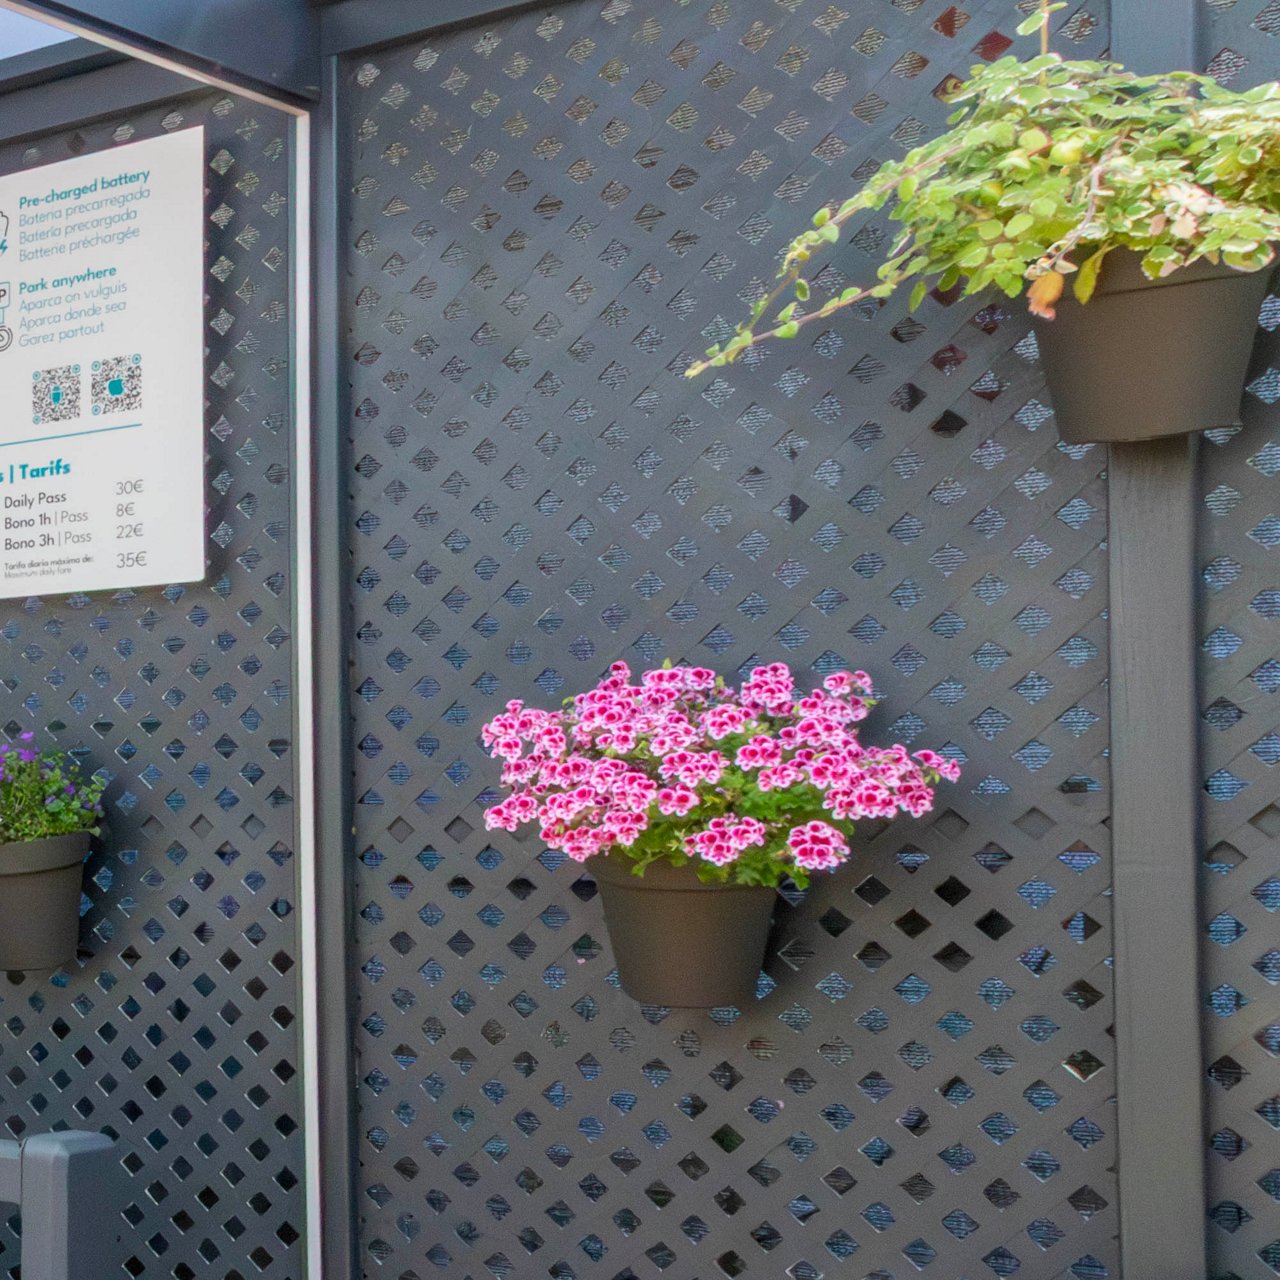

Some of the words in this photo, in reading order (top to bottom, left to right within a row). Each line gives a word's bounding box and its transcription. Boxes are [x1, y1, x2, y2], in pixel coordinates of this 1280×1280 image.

[19, 178, 98, 209] Pre-charged
[101, 170, 150, 190] battery
[64, 208, 137, 237] precargada
[19, 243, 66, 262] Batterie
[19, 278, 48, 295] Park
[52, 266, 117, 288] anywhere
[18, 296, 62, 314] Aparca
[84, 280, 128, 300] vulguis
[19, 314, 61, 331] Aparca
[64, 304, 102, 322] donde
[105, 301, 127, 313] sea
[19, 332, 54, 348] Garez
[59, 322, 104, 343] partout
[19, 458, 72, 480] Tarifs
[116, 479, 144, 496] 30€
[4, 494, 35, 510] Daily
[38, 491, 67, 505] Pass
[116, 502, 136, 517] 8€
[4, 517, 35, 530] Bono
[39, 512, 51, 525] 1h
[61, 510, 89, 524] Pass
[4, 537, 35, 551] Bono
[39, 533, 55, 548] 3h
[64, 531, 92, 545] Pass
[116, 523, 144, 539] 22€
[116, 551, 148, 569] 35€
